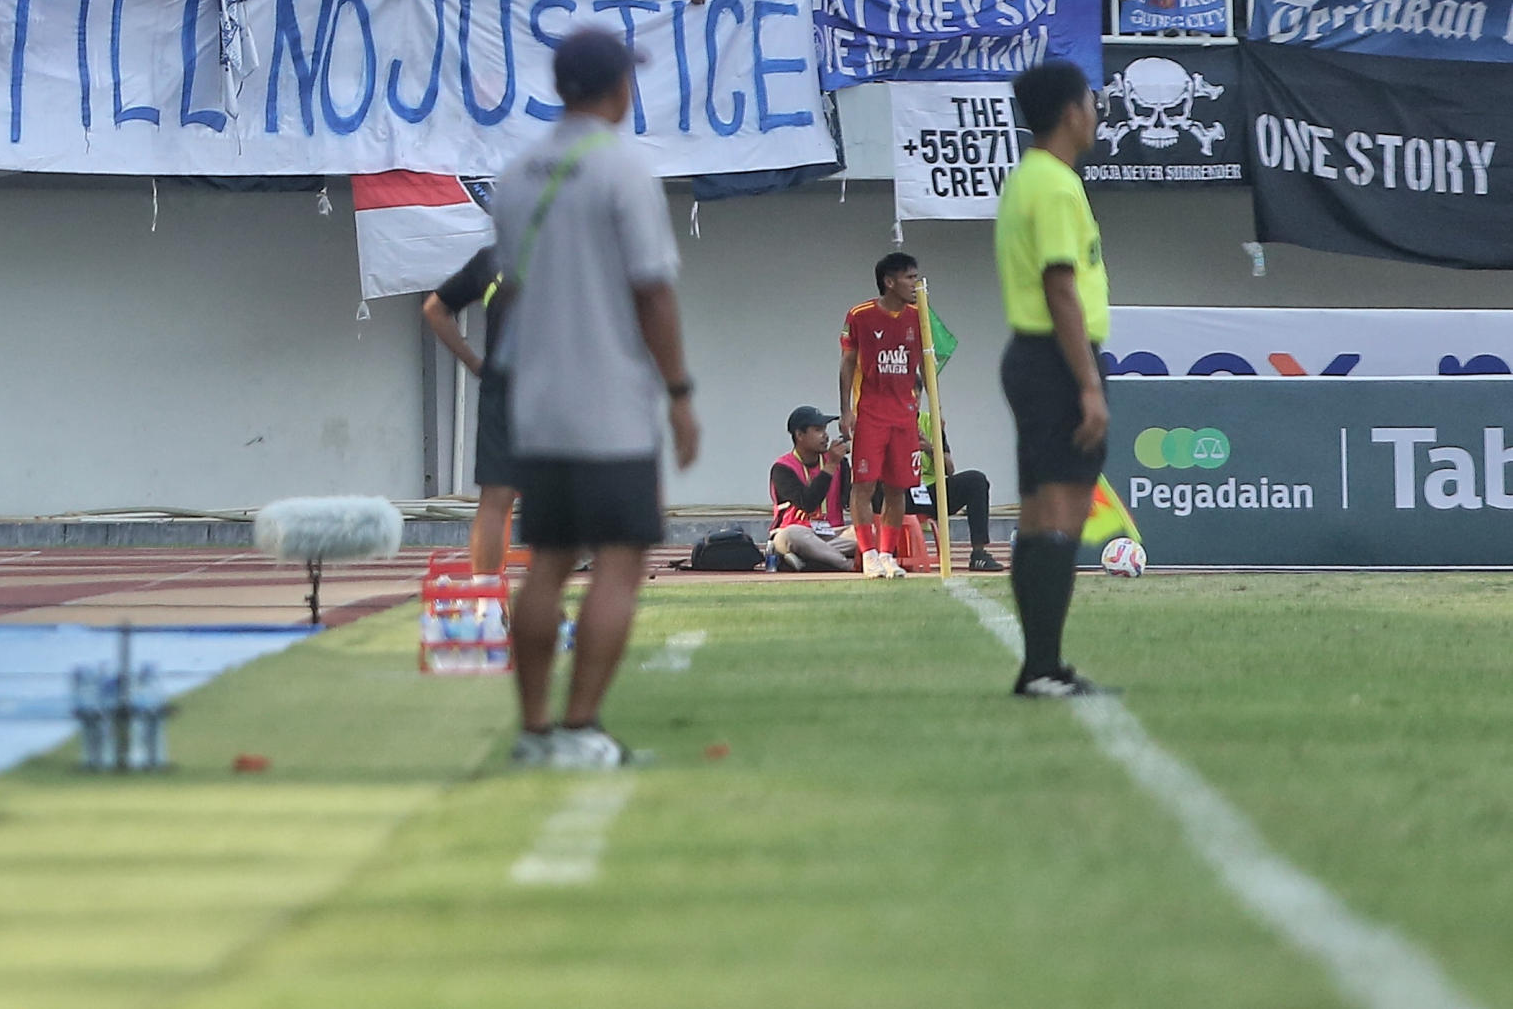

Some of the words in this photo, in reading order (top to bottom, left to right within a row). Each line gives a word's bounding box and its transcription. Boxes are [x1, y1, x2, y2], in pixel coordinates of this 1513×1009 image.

[1186, 7, 1226, 28] CITY
[951, 97, 1009, 128] THE
[903, 129, 1015, 165] +55671
[1255, 113, 1338, 180] ONE
[1344, 130, 1496, 195] STORY
[1121, 165, 1164, 181] NEVER
[1165, 164, 1243, 181] SURRENDER
[877, 345, 910, 365] OASIS
[1129, 476, 1315, 517] Pegadaian
